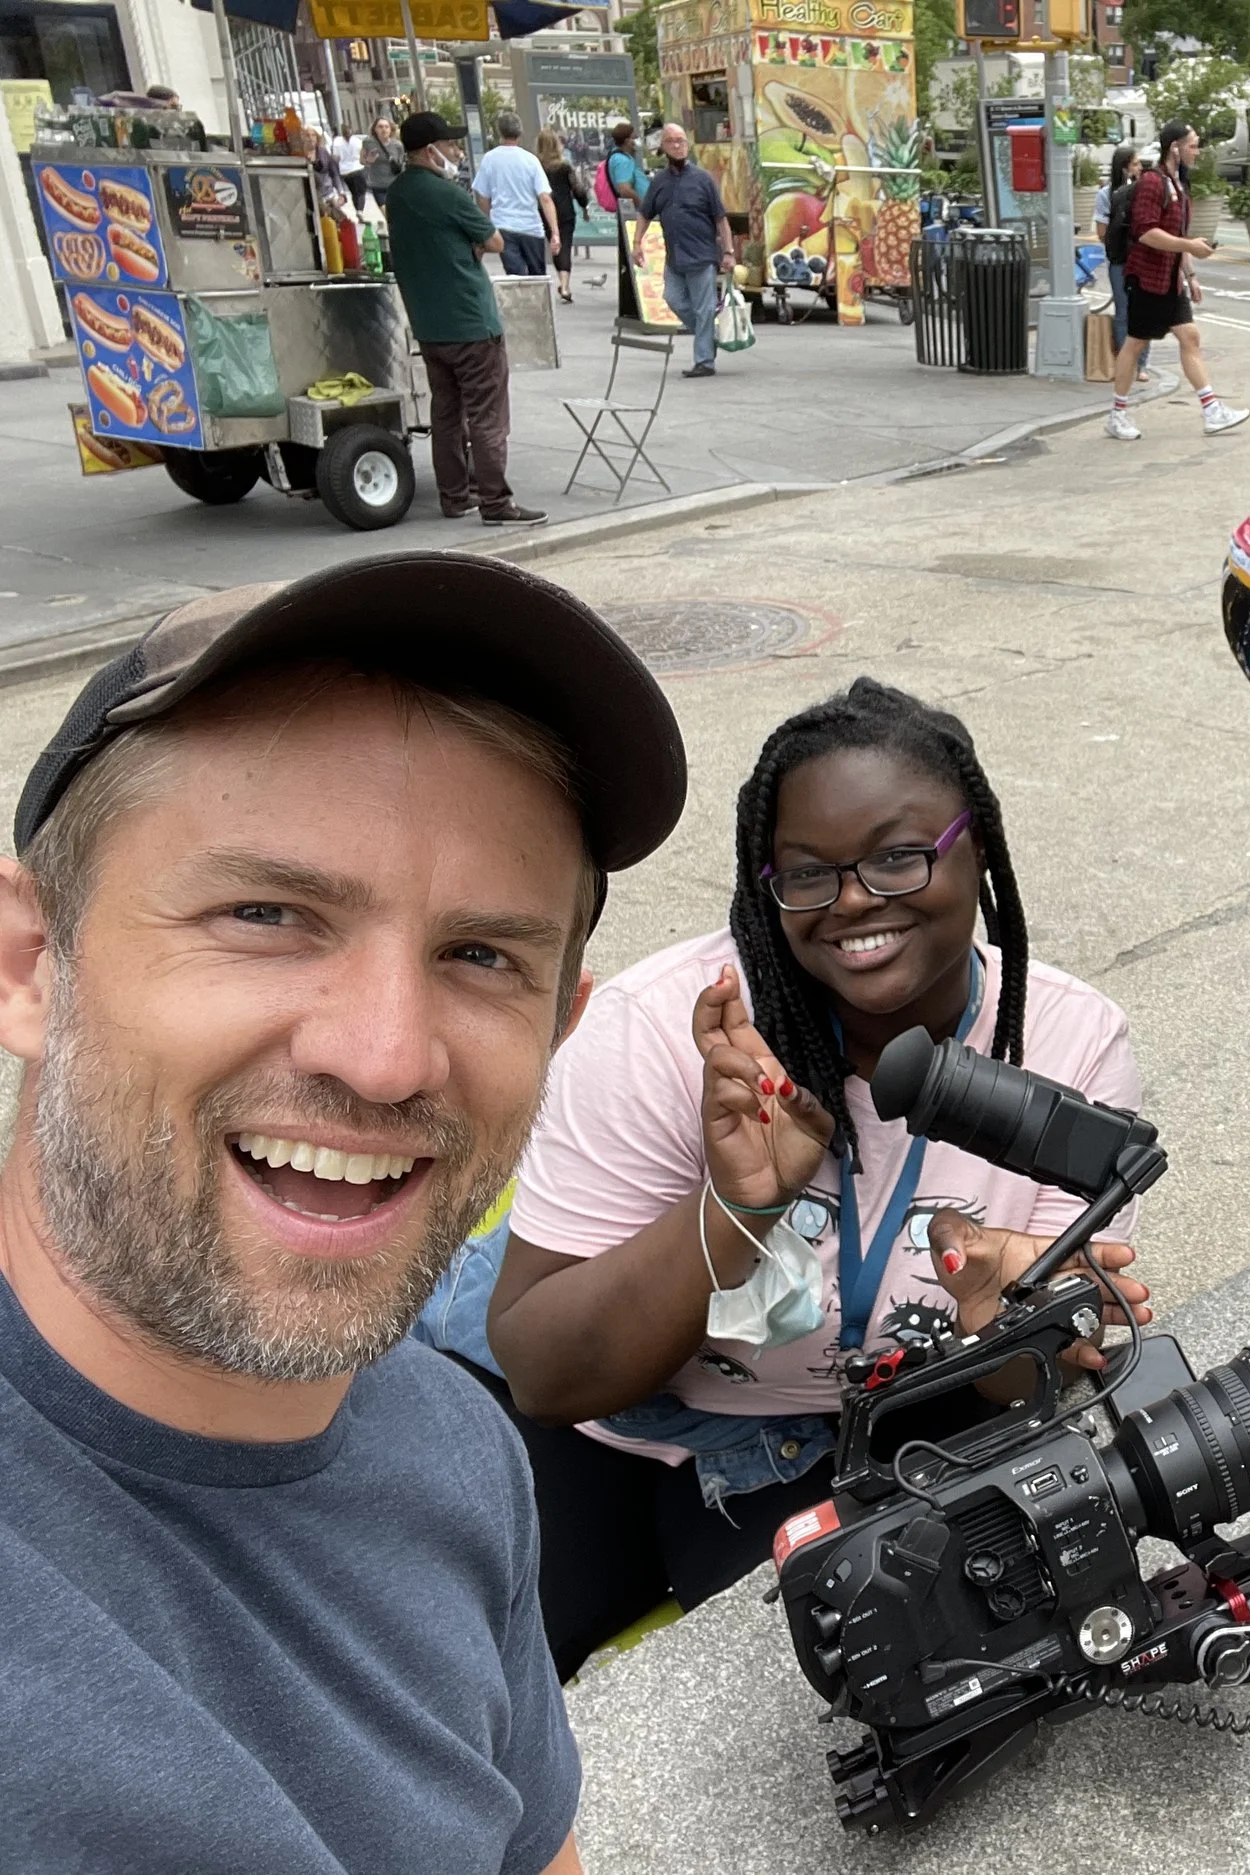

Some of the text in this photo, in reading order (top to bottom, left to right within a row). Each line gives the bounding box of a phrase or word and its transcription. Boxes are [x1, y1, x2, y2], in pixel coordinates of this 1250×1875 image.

[760, 0, 904, 31] Healthy Cart
[546, 98, 568, 124] get
[557, 111, 607, 130] THERE
[1012, 1457, 1044, 1475] Exmor
[1176, 1483, 1199, 1498] SONY
[1121, 1641, 1168, 1673] SHAPE
